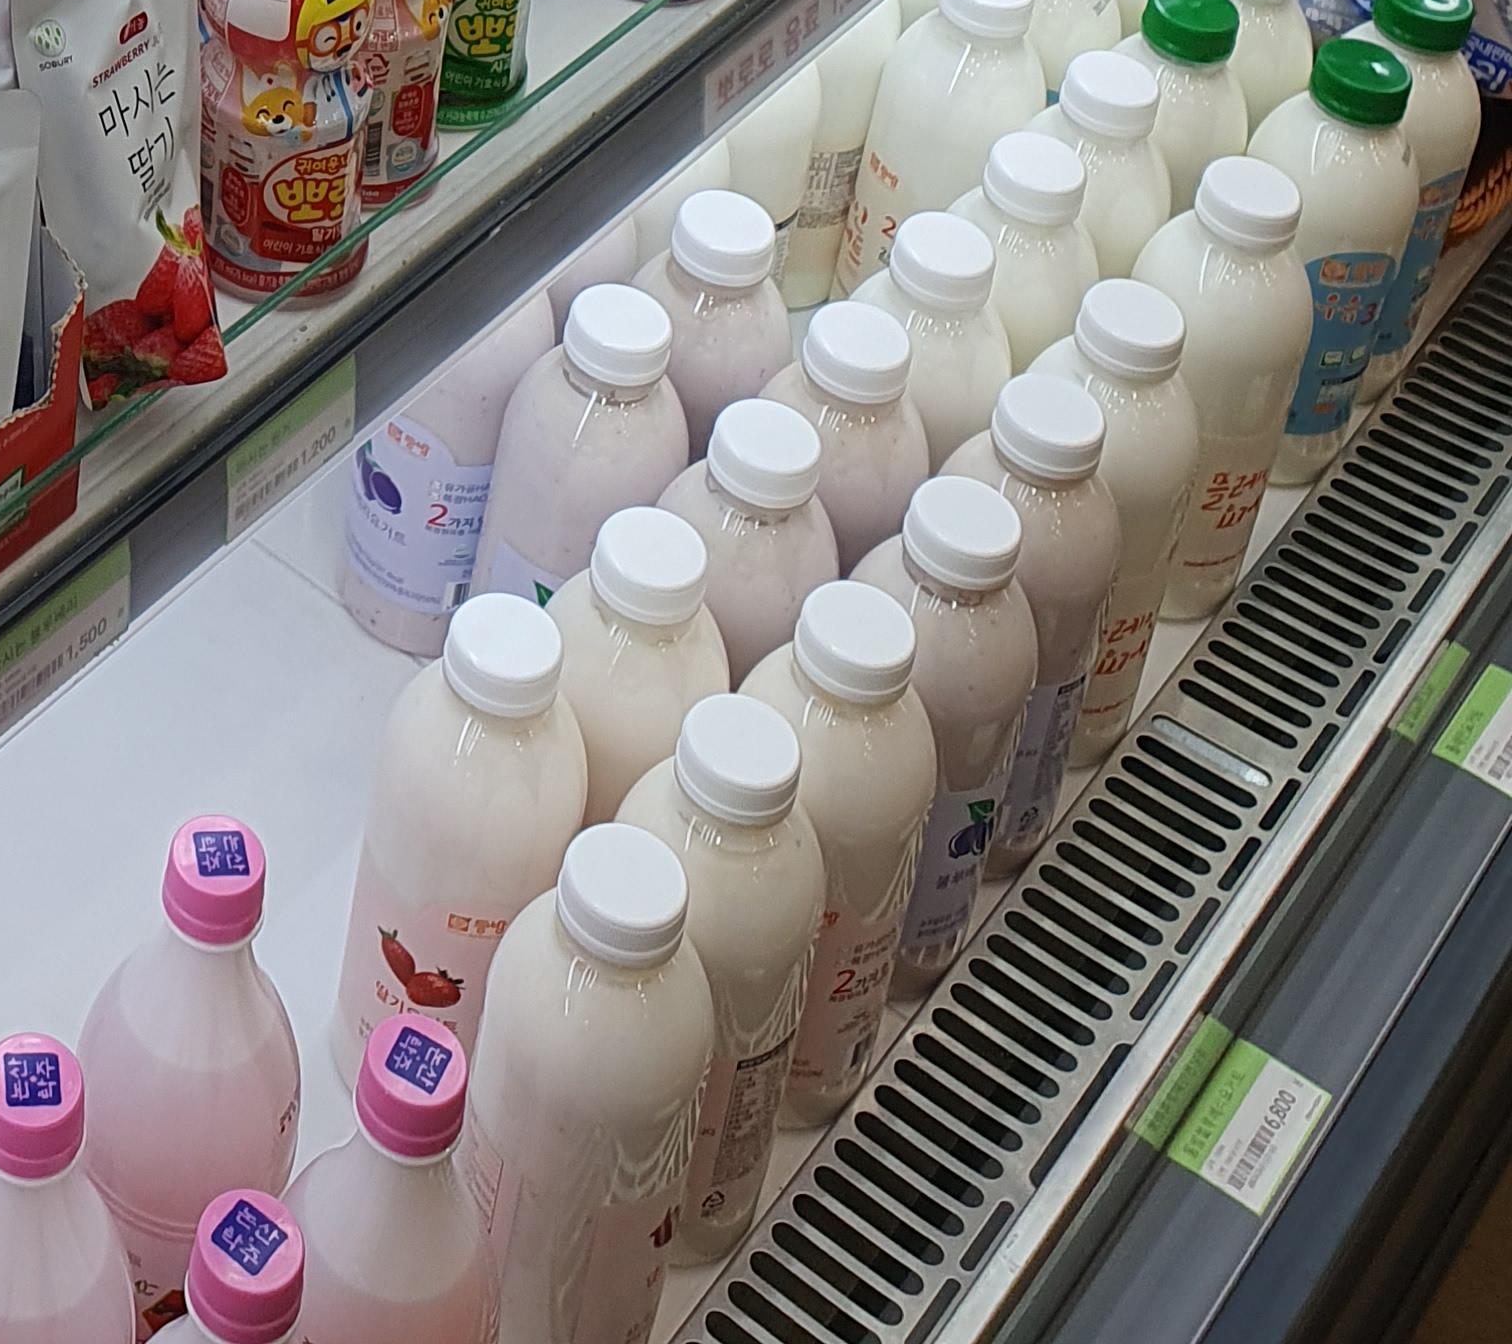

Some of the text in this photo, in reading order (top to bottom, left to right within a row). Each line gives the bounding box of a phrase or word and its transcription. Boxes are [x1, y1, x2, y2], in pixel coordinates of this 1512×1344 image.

[39, 54, 74, 72] SOBURY
[91, 40, 150, 89] STRAWBERRY
[717, 39, 776, 111] 뽀로로
[784, 0, 820, 56] 음료
[98, 61, 176, 139] 마시는
[128, 115, 174, 191] 딸기
[296, 156, 340, 175] 귀여운
[299, 425, 336, 466] 1,200
[66, 617, 108, 662] 1,500
[1268, 1089, 1297, 1132] 6,800
